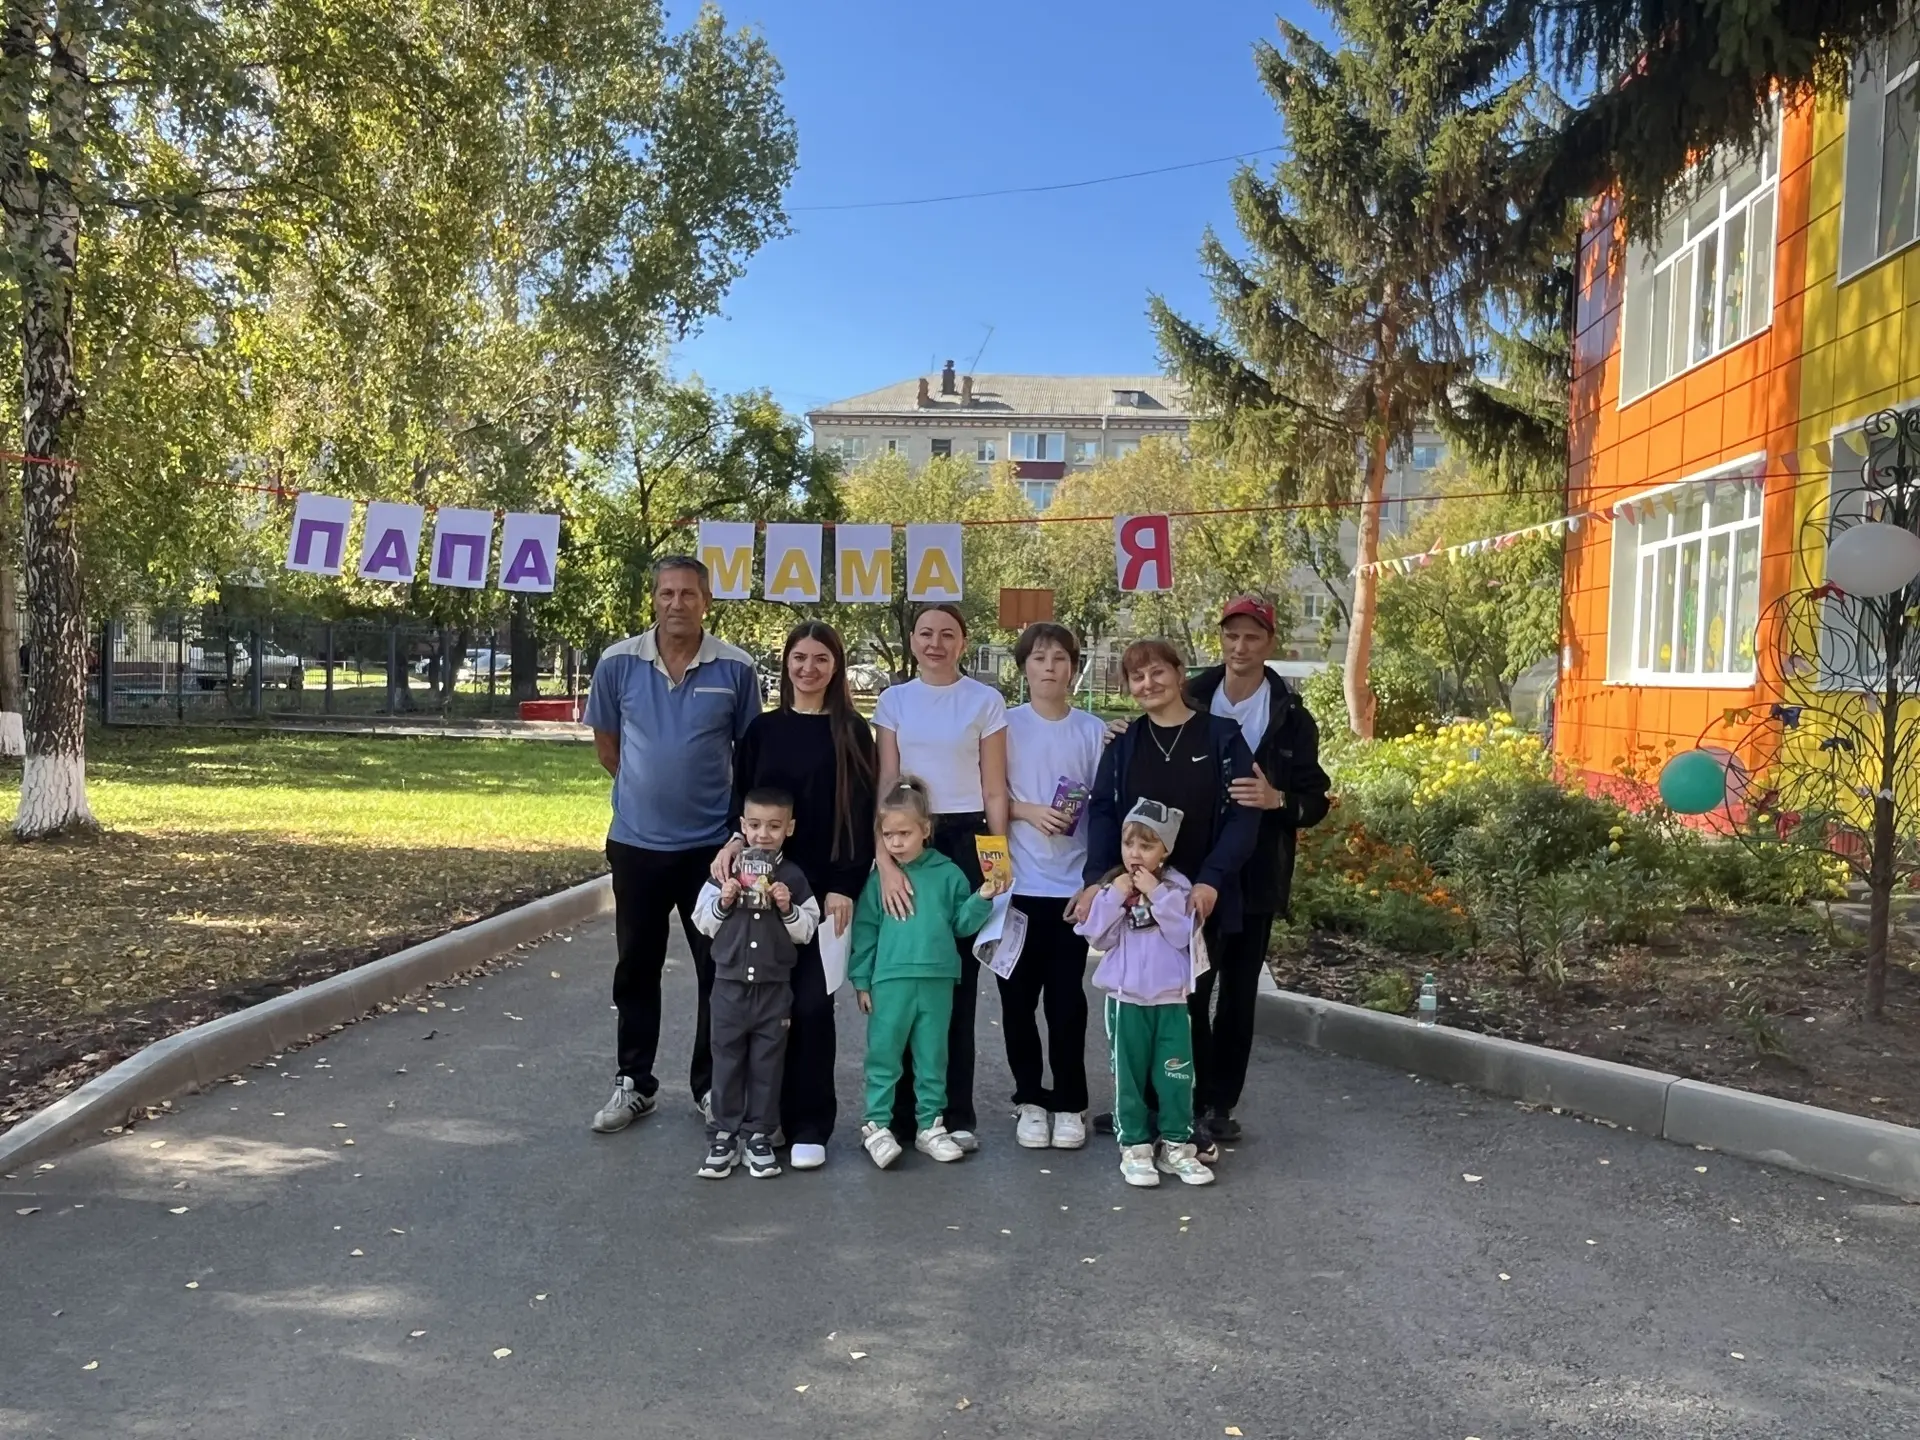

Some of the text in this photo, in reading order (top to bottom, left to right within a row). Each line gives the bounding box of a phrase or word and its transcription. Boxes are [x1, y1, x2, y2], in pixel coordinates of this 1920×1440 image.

[294, 514, 1173, 596] ПАПА МАМА Я
